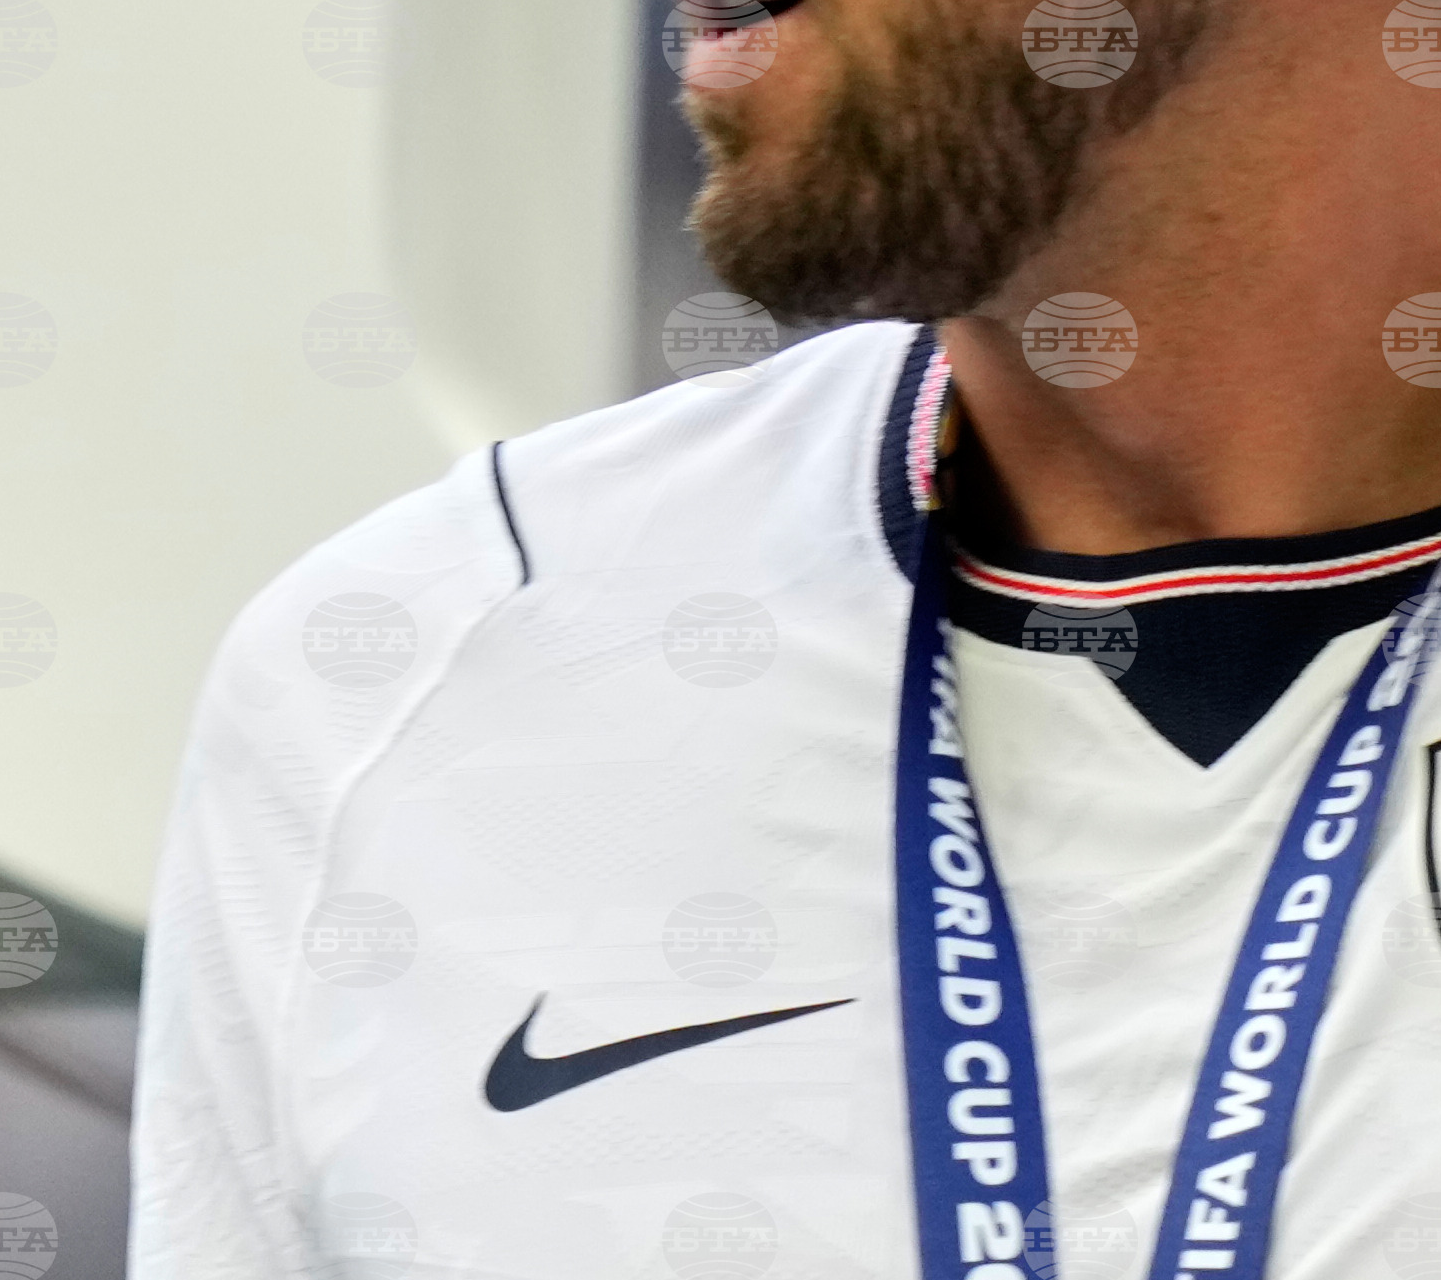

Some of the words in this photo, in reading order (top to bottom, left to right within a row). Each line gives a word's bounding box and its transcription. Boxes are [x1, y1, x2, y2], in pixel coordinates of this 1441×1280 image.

[927, 775, 1003, 1027] WORLD
[1207, 873, 1333, 1142] WORLD
[1303, 724, 1388, 862] CUP
[944, 1039, 1018, 1187] CUP
